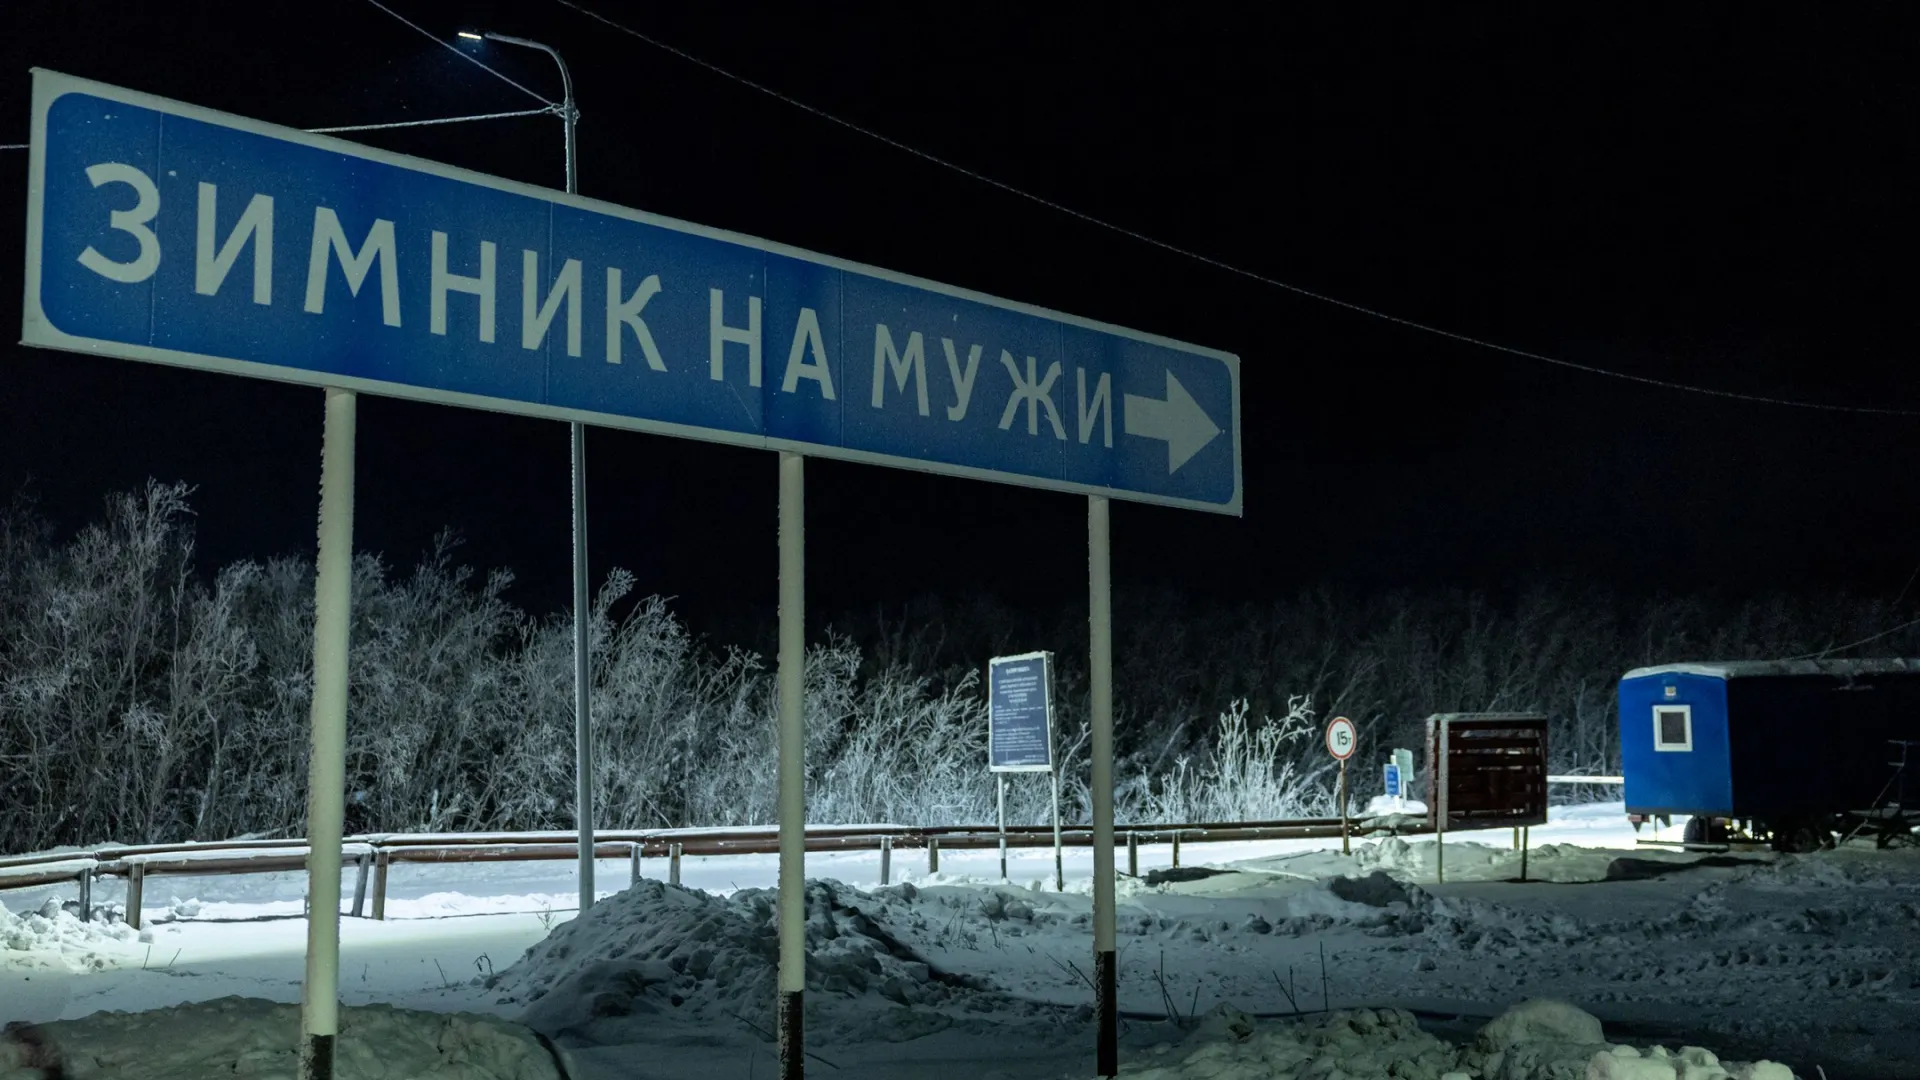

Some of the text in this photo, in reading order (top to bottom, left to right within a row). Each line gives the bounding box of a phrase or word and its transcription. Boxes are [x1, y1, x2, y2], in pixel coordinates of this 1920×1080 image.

[77, 162, 1114, 448] ЗИМНИК НА МУЖИ
